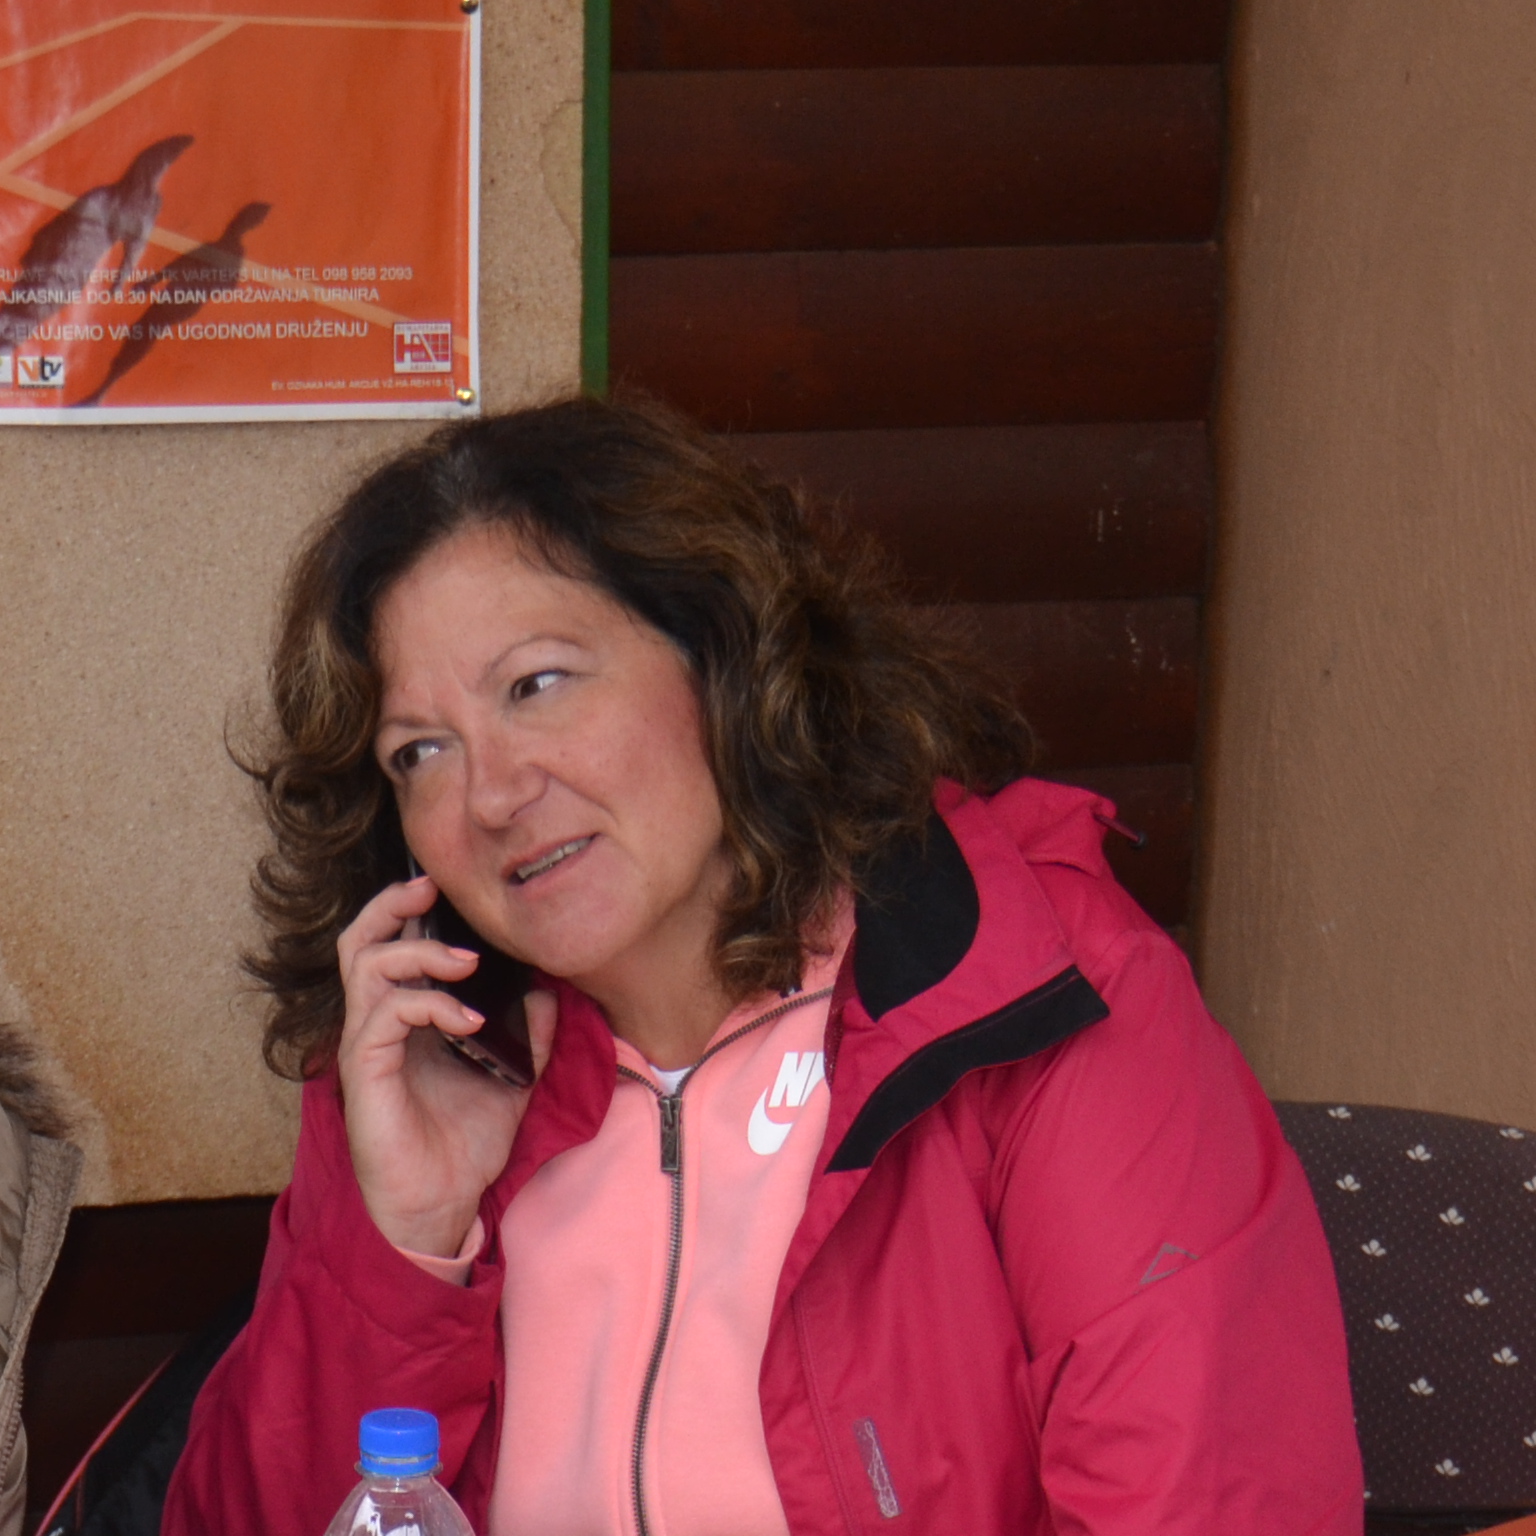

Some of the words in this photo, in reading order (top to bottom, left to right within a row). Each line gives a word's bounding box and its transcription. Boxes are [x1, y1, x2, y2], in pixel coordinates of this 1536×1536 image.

[271, 268, 292, 281] NA
[294, 267, 319, 281] TEL
[86, 289, 110, 304] DO
[150, 289, 174, 304] NA
[175, 289, 206, 304] DAN
[210, 287, 309, 304] ODRŽAVANJA
[314, 287, 380, 303] TURNIRA
[108, 325, 143, 340] VAS
[149, 325, 173, 340] NA
[178, 323, 272, 340] UGODNOM
[276, 320, 369, 339] DRUŽENJU
